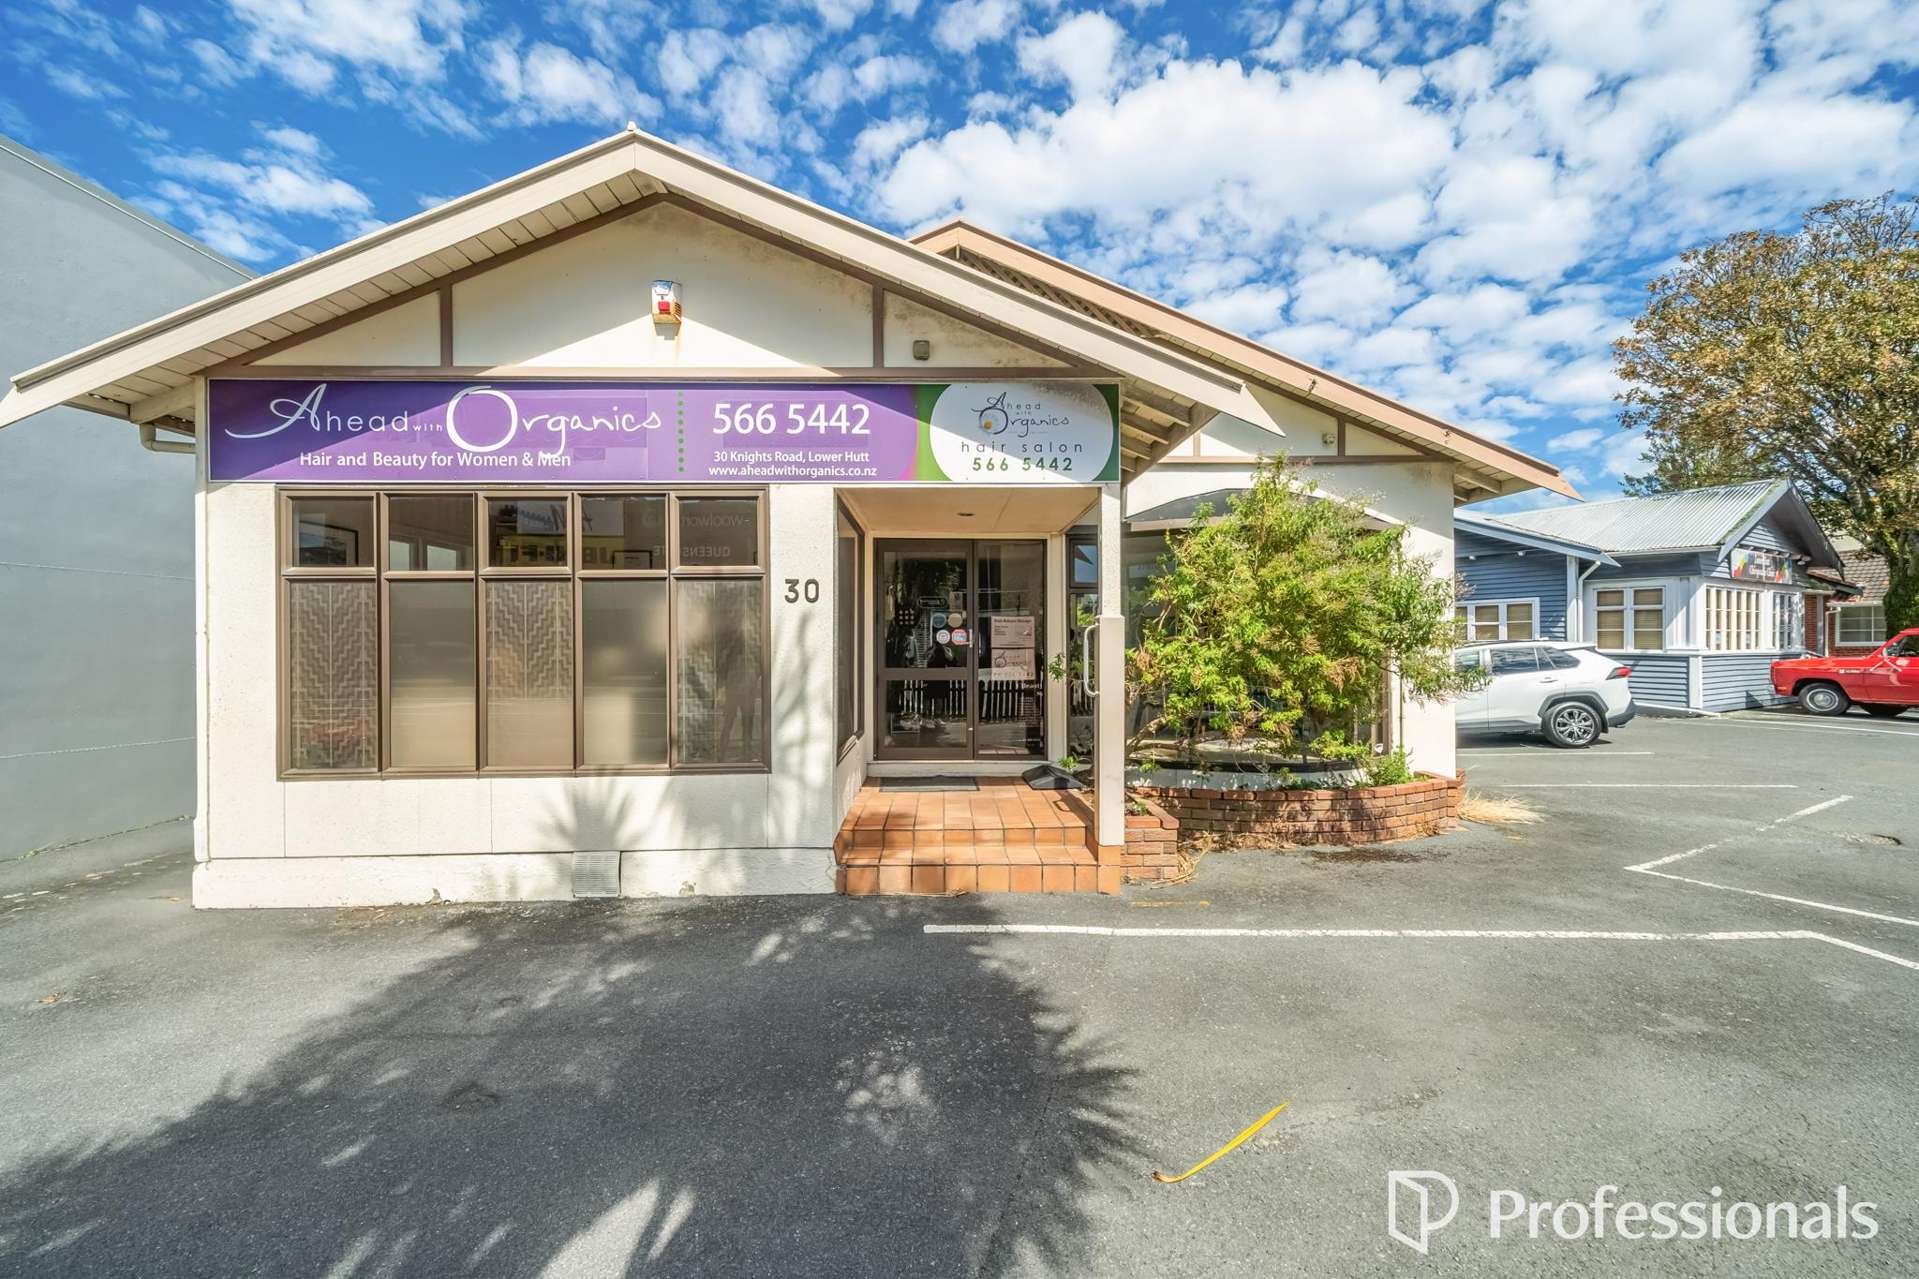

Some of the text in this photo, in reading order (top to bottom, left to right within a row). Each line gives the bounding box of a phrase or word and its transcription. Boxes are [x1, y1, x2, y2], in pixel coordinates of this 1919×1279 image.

[971, 392, 1041, 412] Ahead
[225, 383, 661, 458] Ahead with Organics
[712, 403, 871, 435] 566 5442
[979, 407, 1070, 438] Organics
[961, 441, 1083, 453] hair salon
[300, 452, 571, 471] Hair and Beauty for Women & Men
[714, 450, 870, 466] 30 Knights Road, Lower Hutt
[972, 457, 1073, 472] 566 5442
[709, 465, 877, 479] www.aheadwithorganics.co.nz
[784, 578, 820, 604] 30
